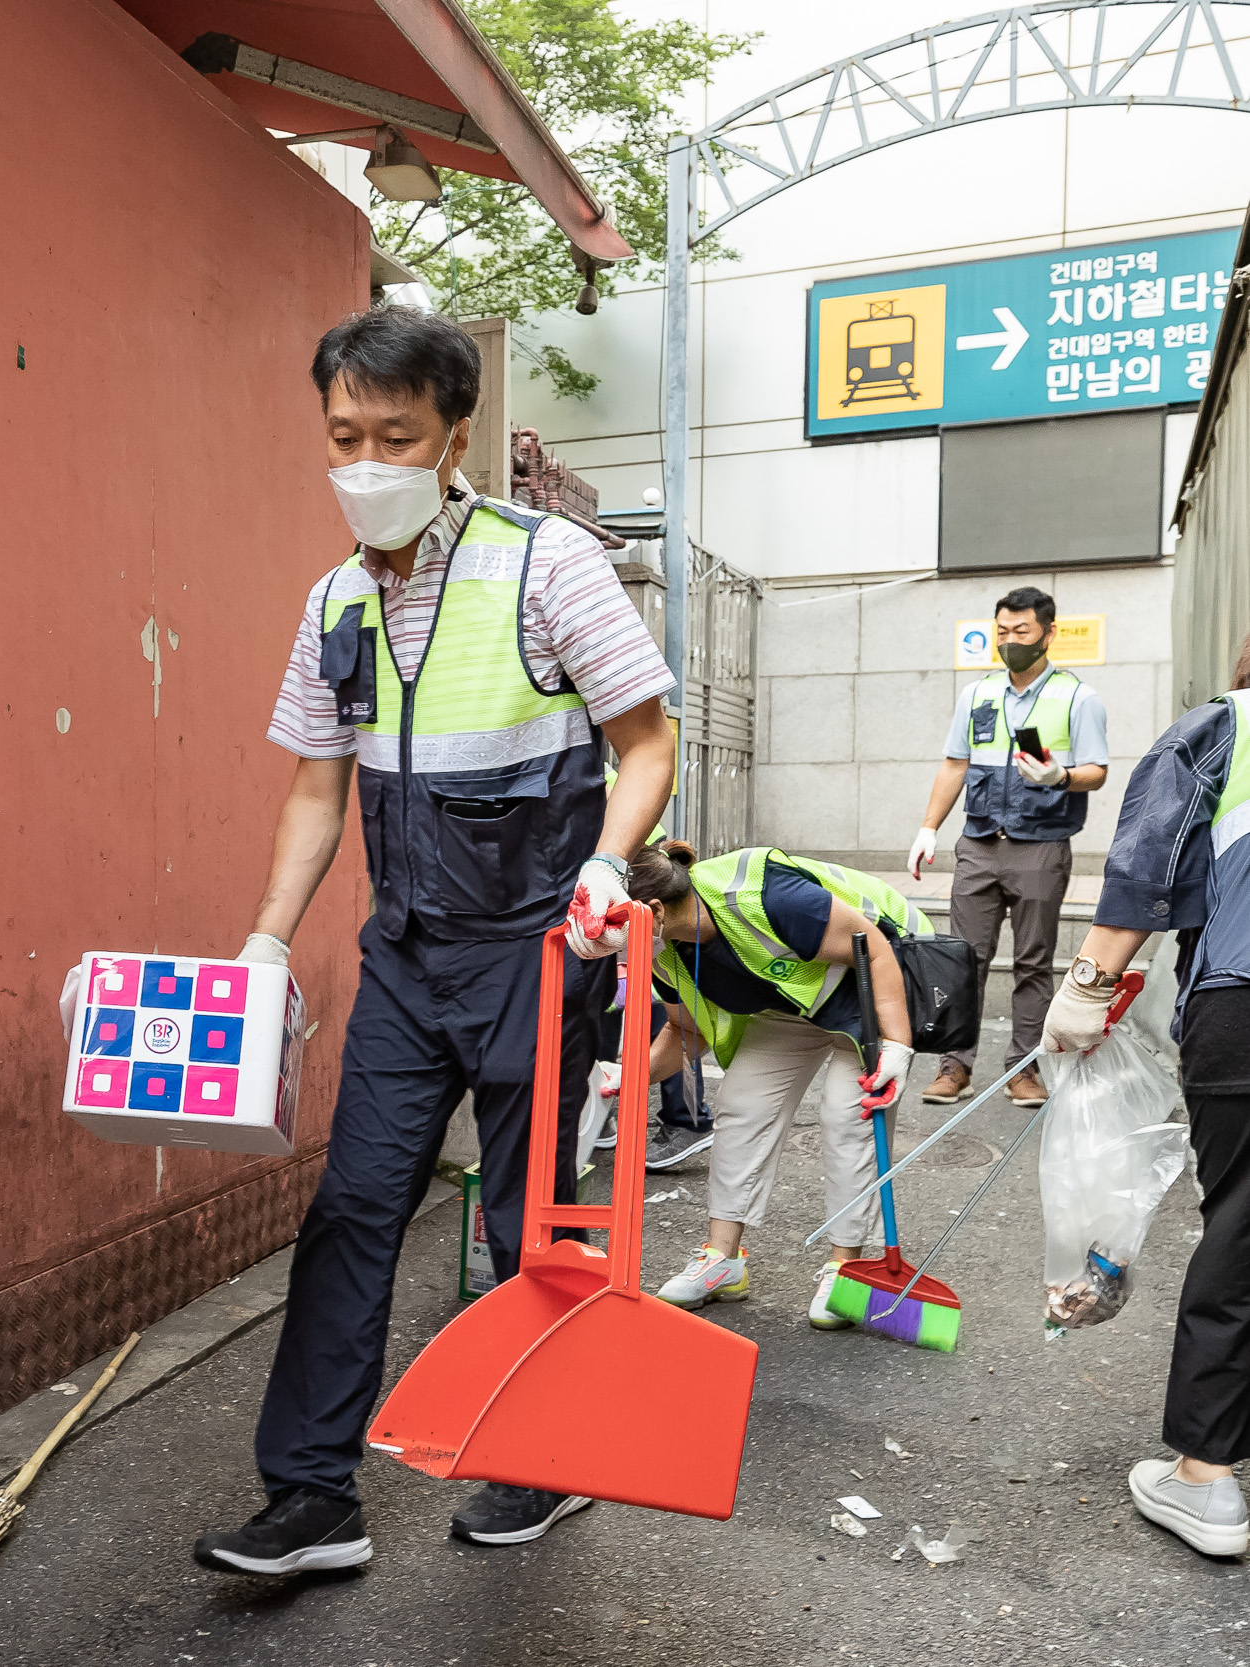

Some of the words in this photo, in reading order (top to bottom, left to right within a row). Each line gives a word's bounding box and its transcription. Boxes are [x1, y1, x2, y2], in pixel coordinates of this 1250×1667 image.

[1049, 251, 1158, 285] 건대입구역
[1047, 327, 1156, 360] 건대입구역
[1162, 322, 1209, 349] 한타
[1046, 354, 1162, 402] 만남의
[152, 1023, 173, 1038] BR
